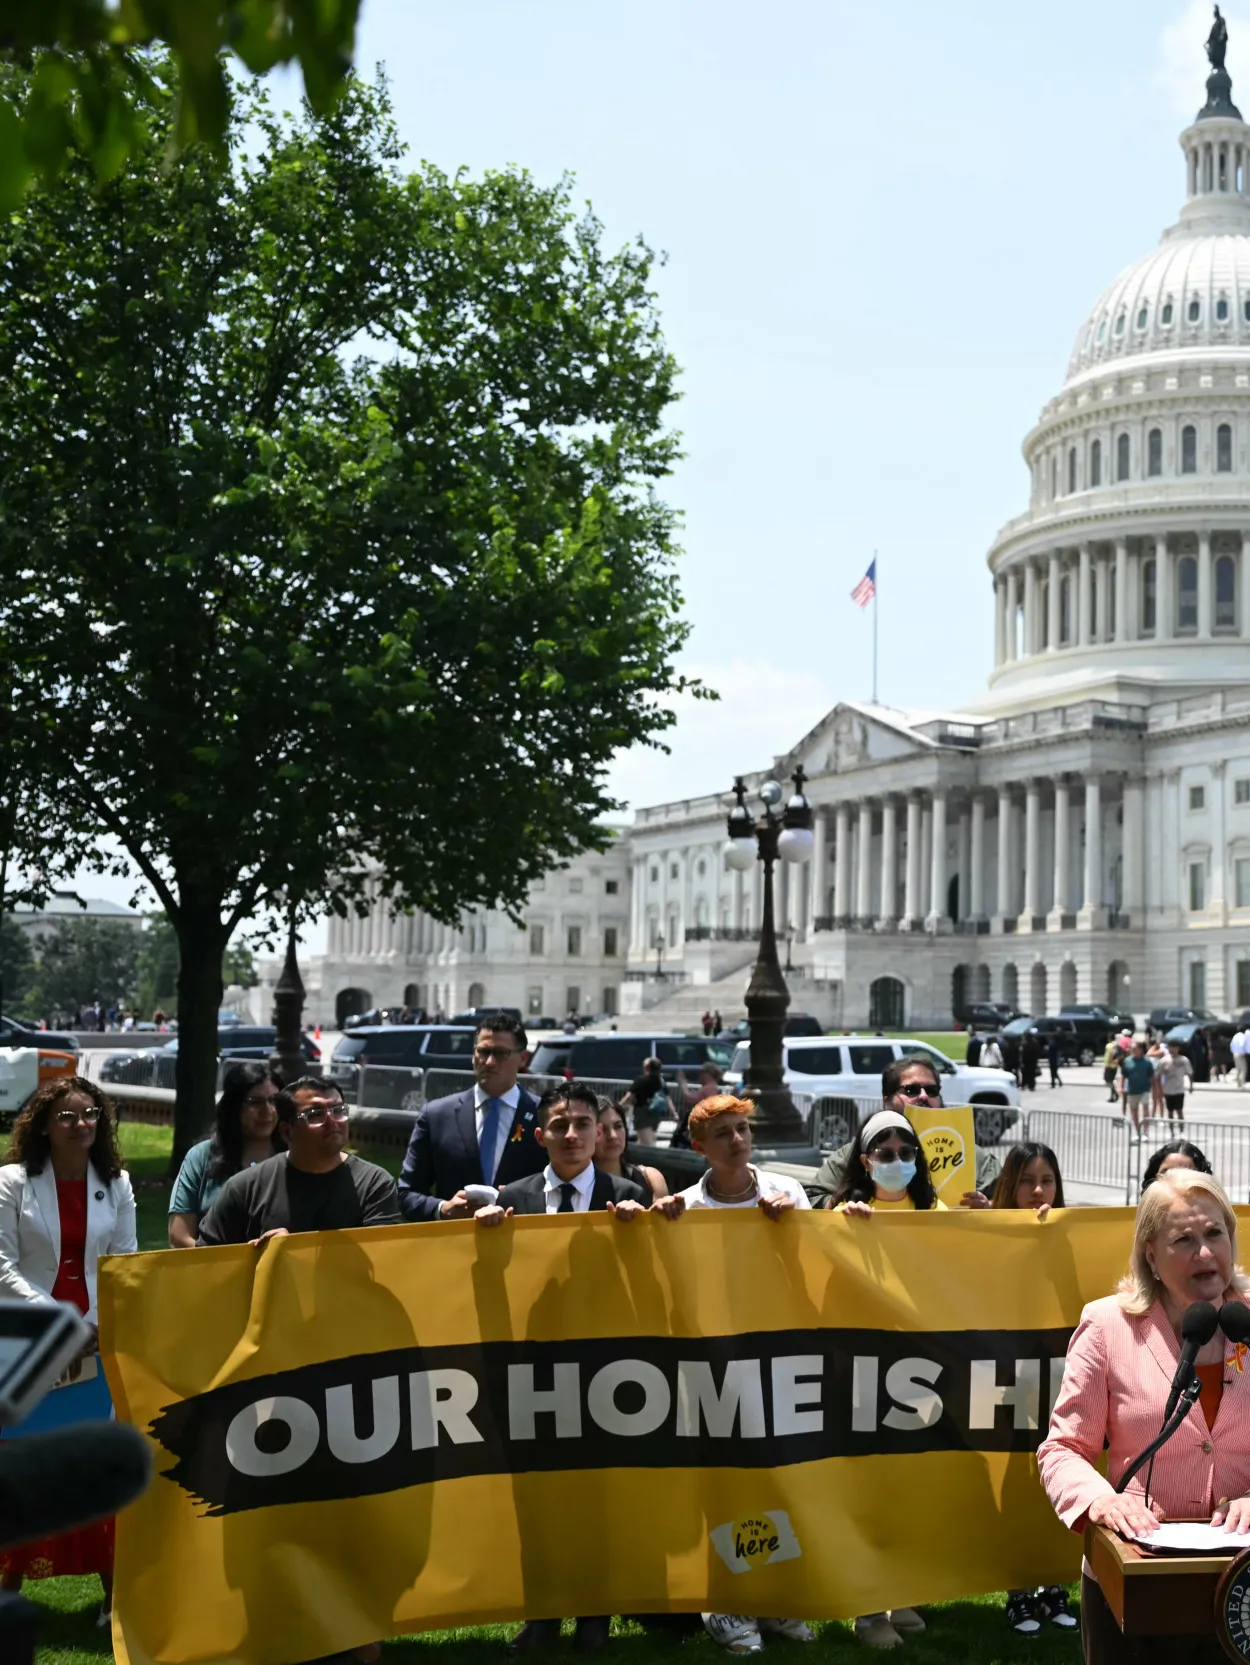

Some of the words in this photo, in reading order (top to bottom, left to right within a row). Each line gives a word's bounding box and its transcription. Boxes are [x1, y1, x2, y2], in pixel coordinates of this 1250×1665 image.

[926, 1137, 955, 1147] HOME
[929, 1151, 963, 1172] ere
[226, 1368, 485, 1477] OUR
[508, 1354, 824, 1439] HOME
[851, 1355, 944, 1432] IS
[969, 1356, 1067, 1430] H
[741, 1520, 769, 1530] HOME
[735, 1532, 779, 1559] here
